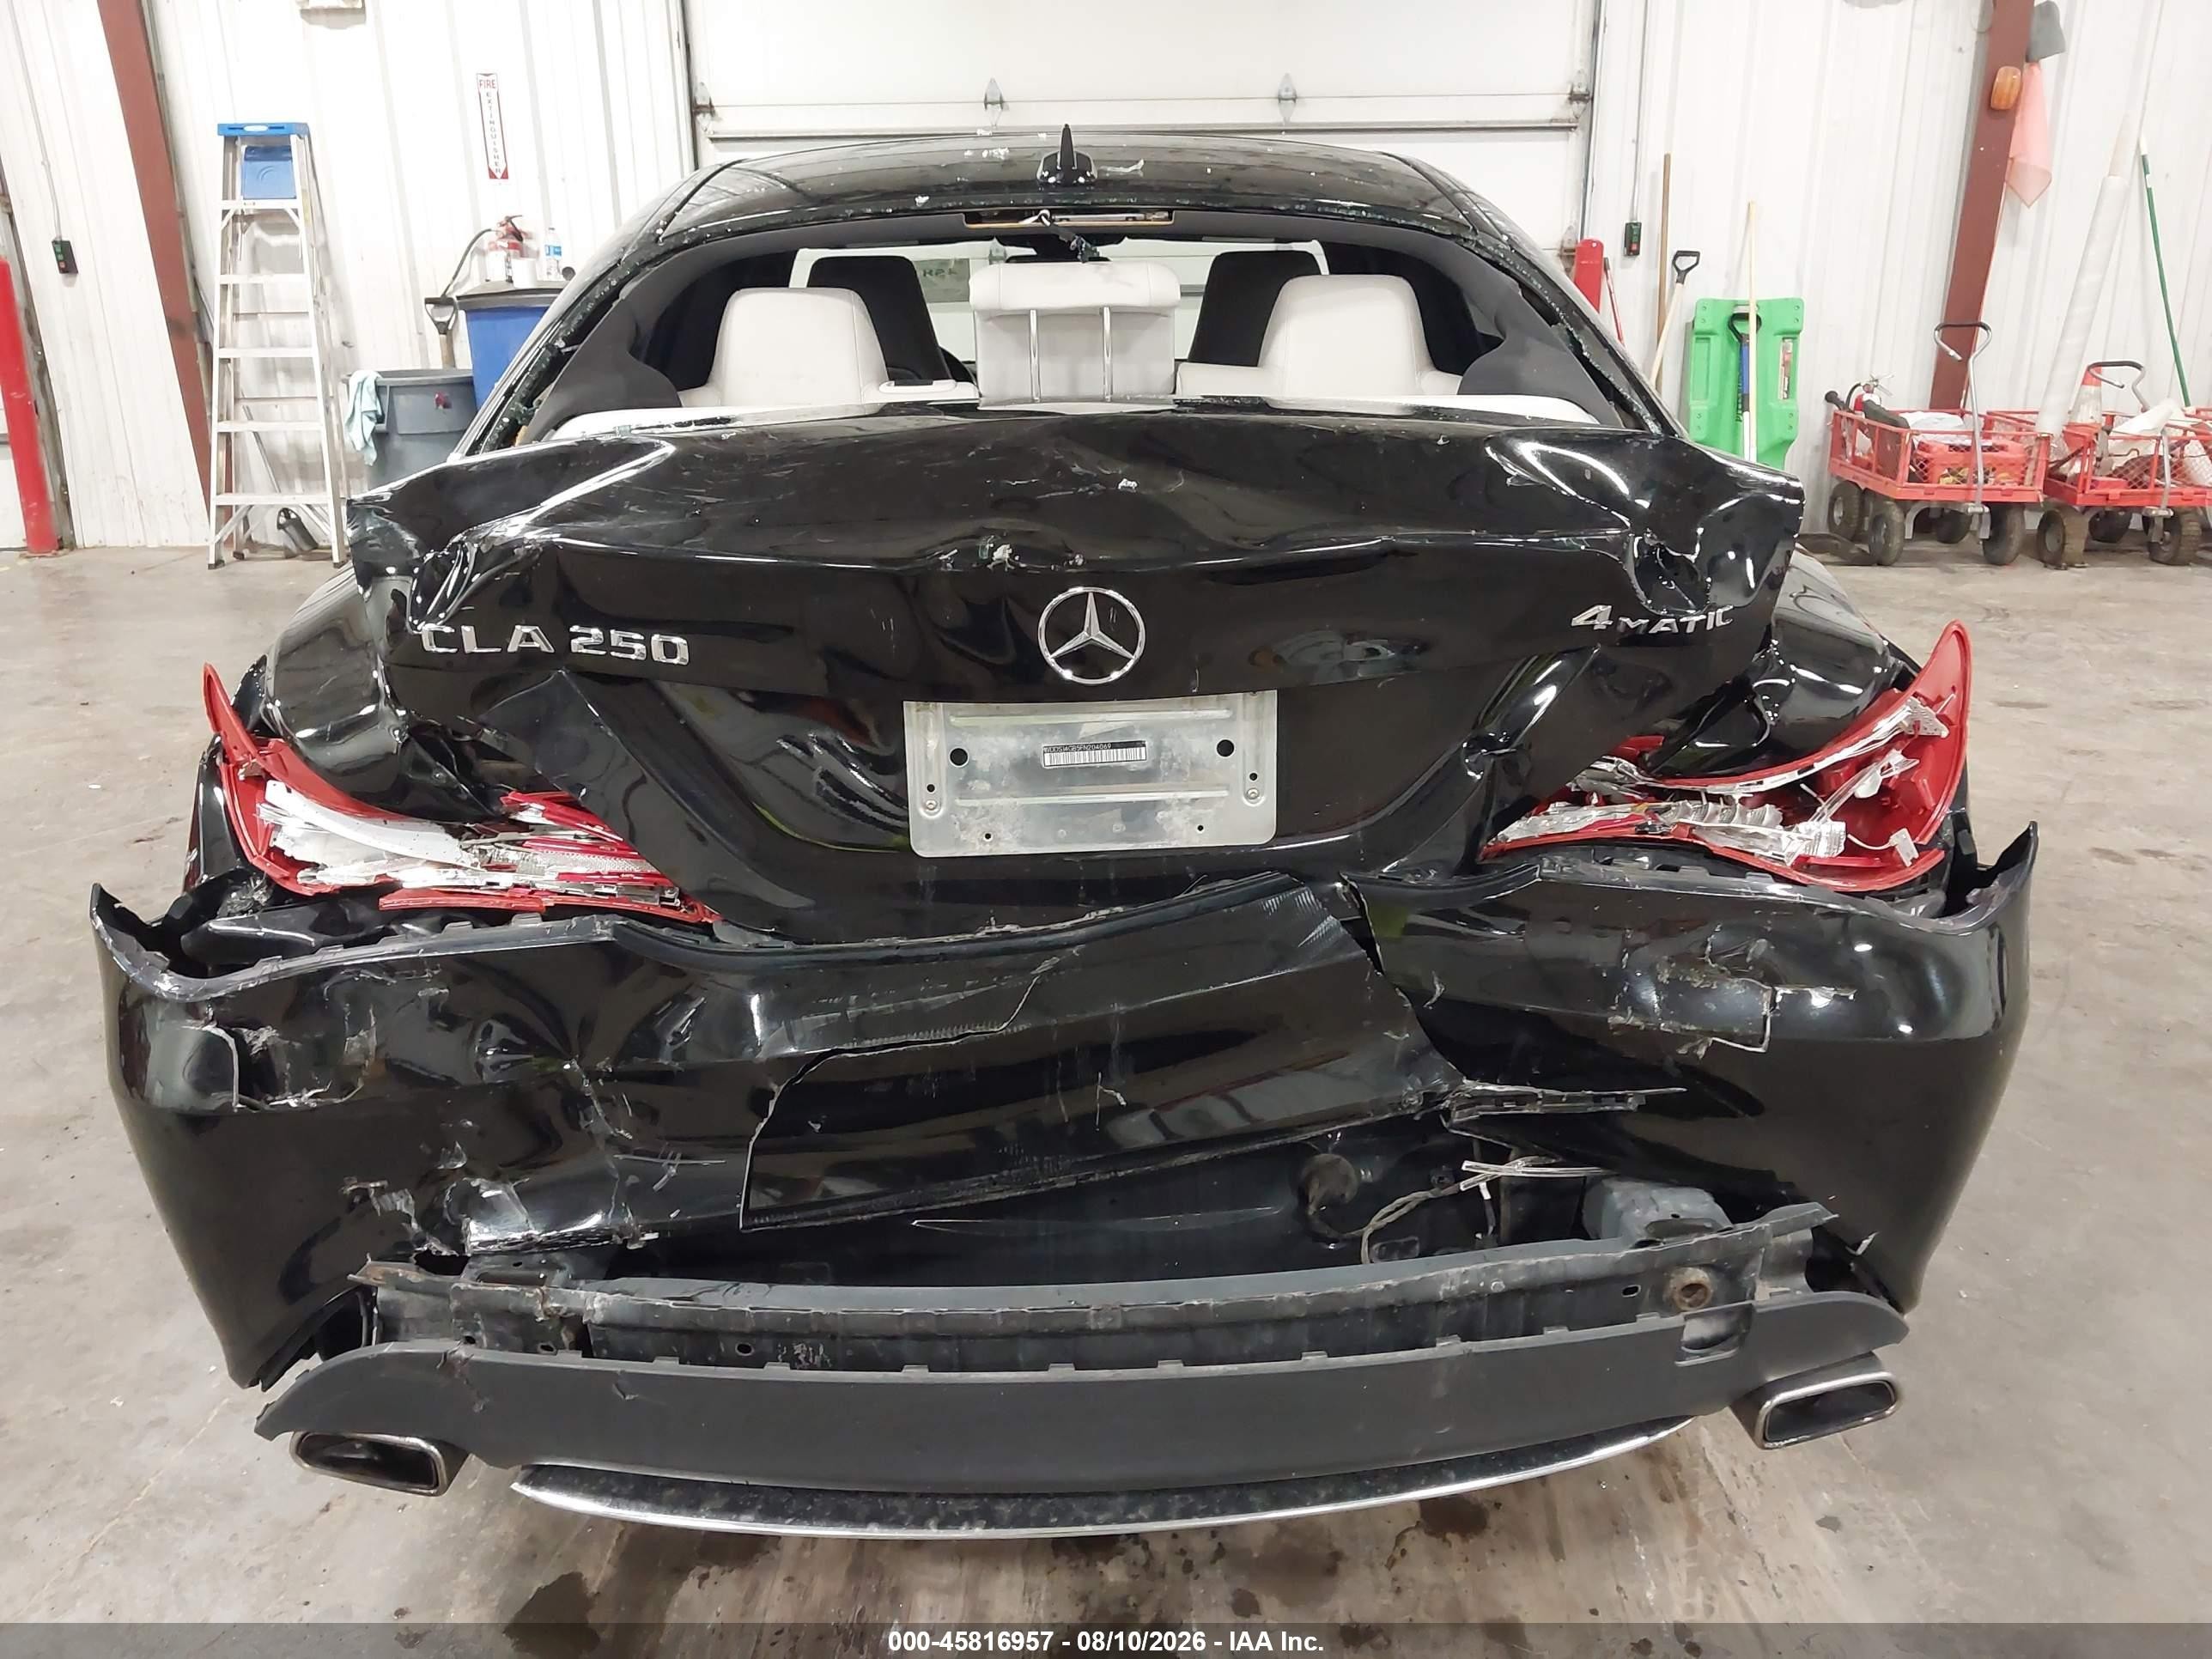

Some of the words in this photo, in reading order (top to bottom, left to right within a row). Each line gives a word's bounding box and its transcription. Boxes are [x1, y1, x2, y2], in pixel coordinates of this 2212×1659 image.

[479, 79, 495, 89] FIRE
[422, 623, 555, 653] CLA
[569, 625, 690, 665] 250
